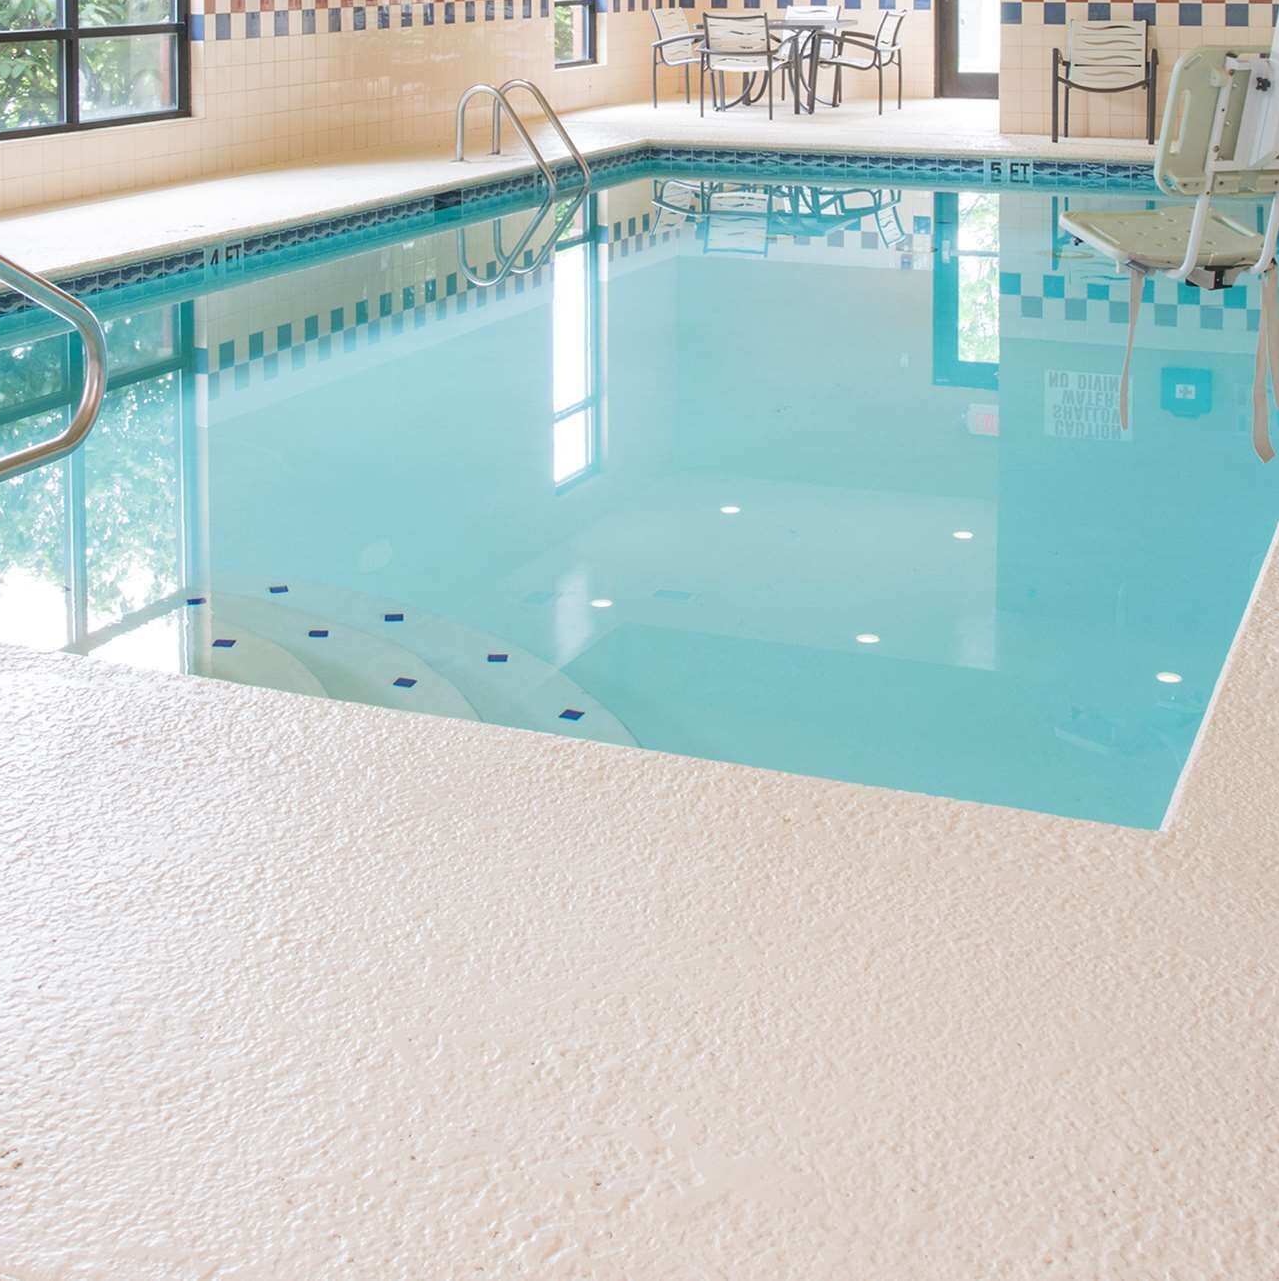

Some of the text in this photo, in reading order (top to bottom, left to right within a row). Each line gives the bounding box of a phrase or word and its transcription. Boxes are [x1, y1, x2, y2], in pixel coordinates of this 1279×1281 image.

[991, 162, 1030, 175] 5 FT
[225, 244, 242, 262] FT
